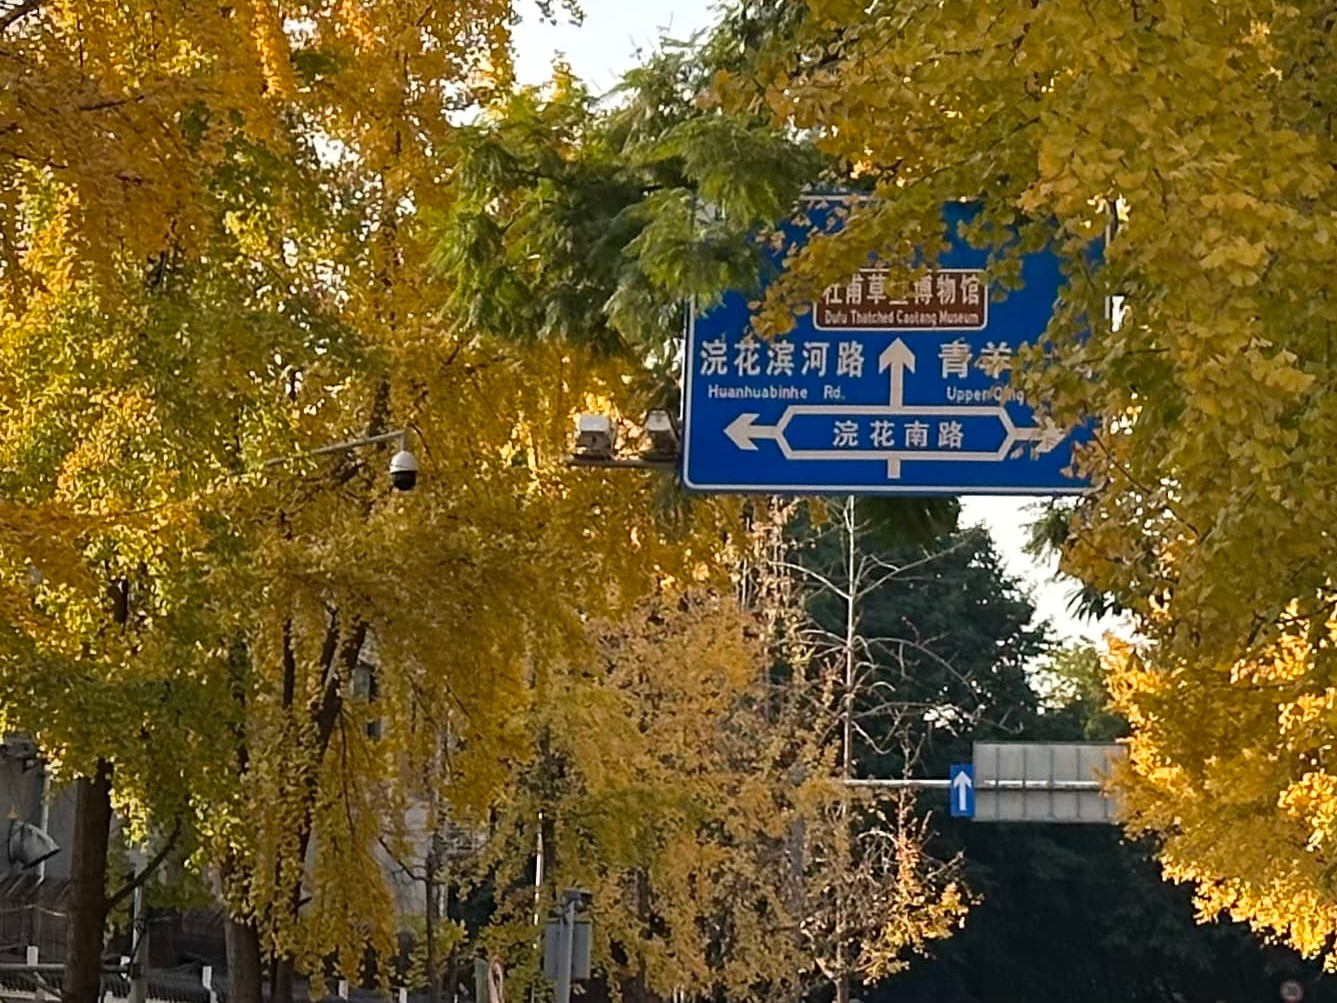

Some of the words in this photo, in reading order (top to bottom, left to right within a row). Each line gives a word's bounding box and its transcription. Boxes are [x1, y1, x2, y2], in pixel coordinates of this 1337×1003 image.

[823, 274, 980, 305] 杜甫草博物馆
[825, 310, 847, 324] Dufu
[851, 310, 894, 324] Thatched
[896, 310, 936, 326] Caotang
[939, 310, 978, 324] Museum
[700, 339, 865, 377] 浣花滨河路
[708, 385, 808, 399] Huanhuabinhe
[824, 385, 845, 399] Rd.
[946, 387, 987, 403] Upper
[832, 420, 964, 448] 浣花南路
